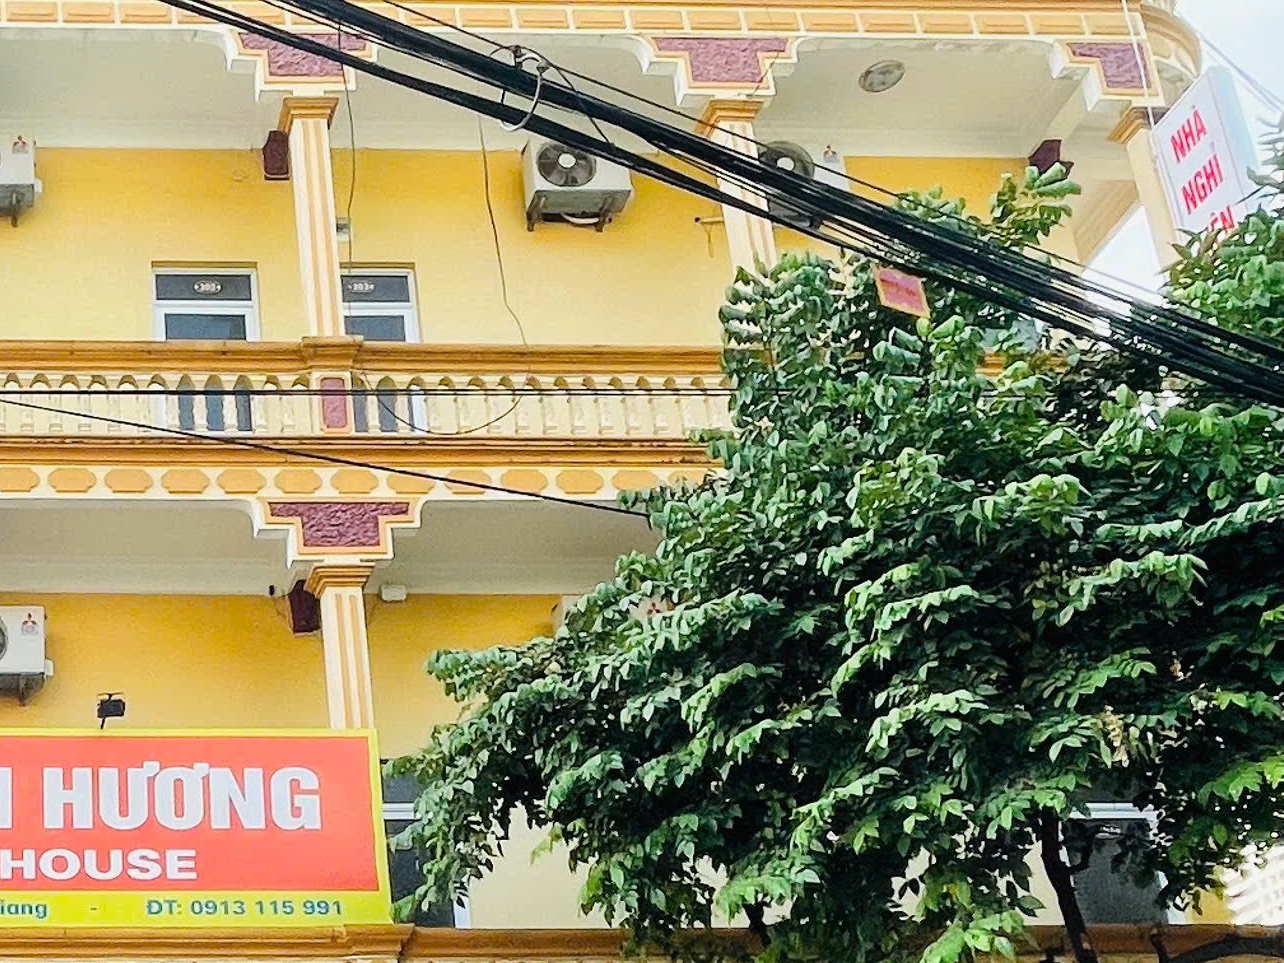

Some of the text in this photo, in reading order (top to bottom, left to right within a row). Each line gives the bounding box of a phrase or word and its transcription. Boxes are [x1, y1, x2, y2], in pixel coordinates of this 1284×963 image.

[44, 760, 322, 831] HƯƠNG
[0, 847, 198, 880] HOUSE
[147, 900, 182, 915] ĐT:
[190, 900, 246, 915] 0913
[256, 900, 294, 915] 115
[303, 900, 342, 915] 991
